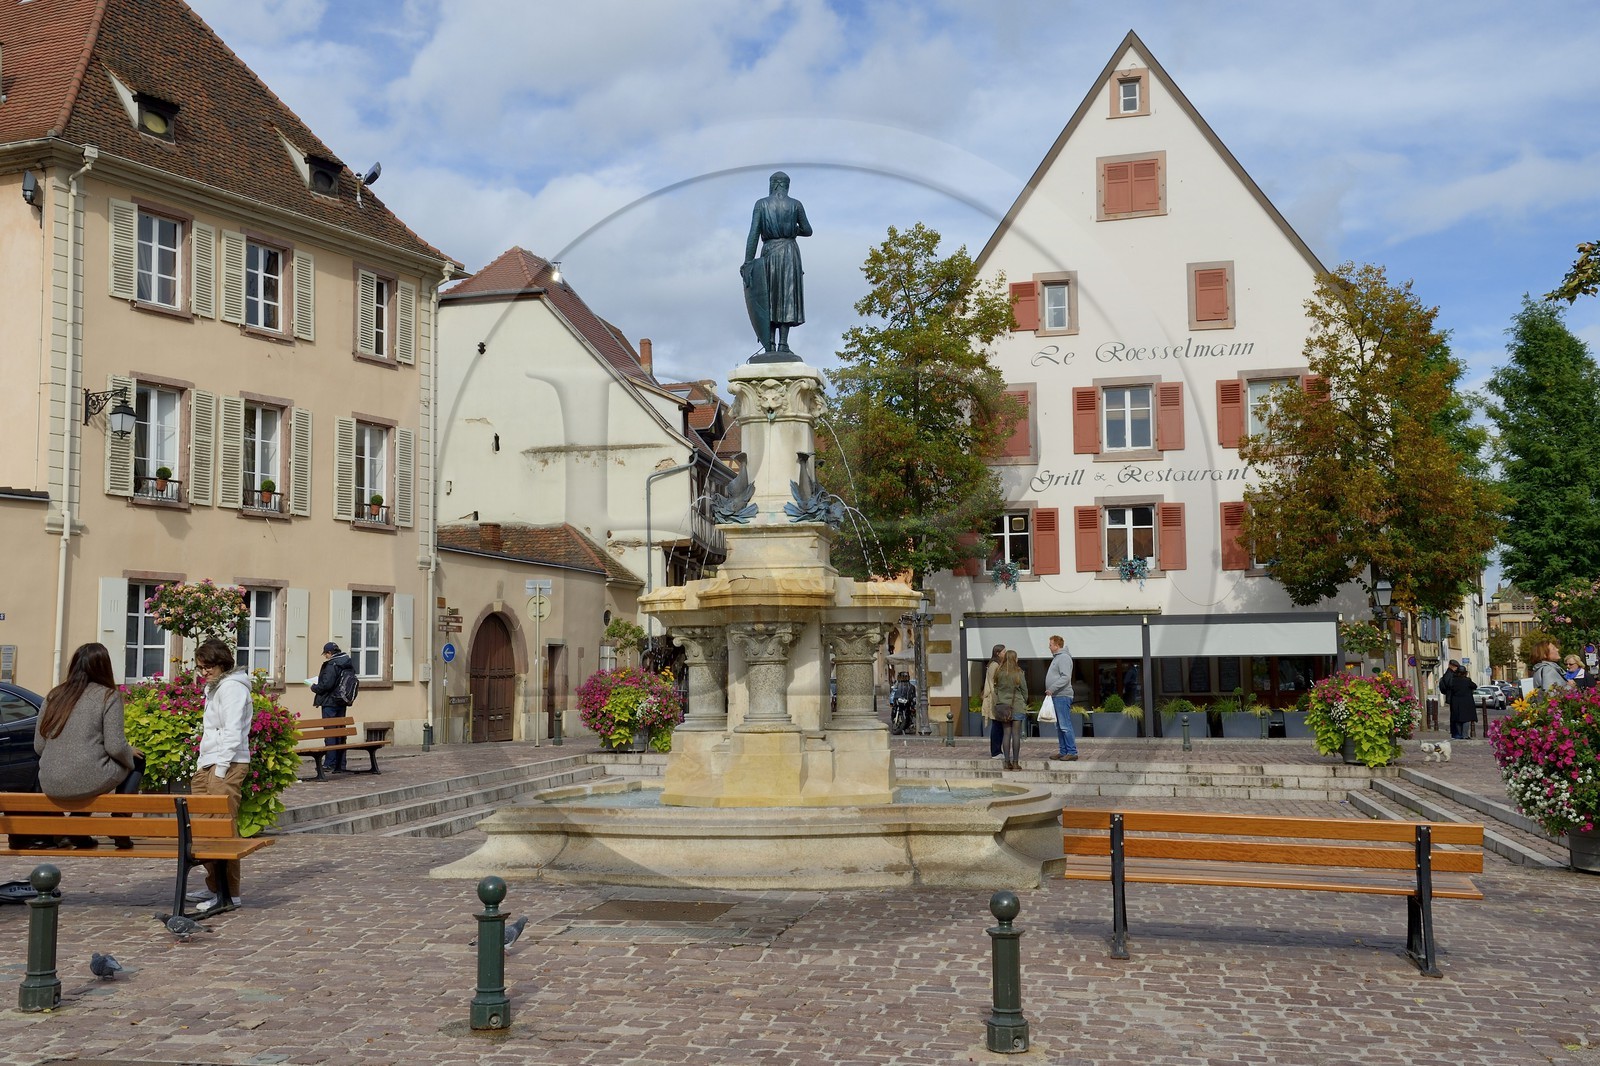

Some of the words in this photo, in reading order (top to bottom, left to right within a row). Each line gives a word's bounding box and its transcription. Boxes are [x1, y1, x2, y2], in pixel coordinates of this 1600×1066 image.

[1030, 344, 1075, 367] Le
[1095, 337, 1255, 363] Roesselmann
[1029, 469, 1086, 493] Grill
[1093, 472, 1106, 482] &
[1117, 464, 1249, 484] Restaurant
